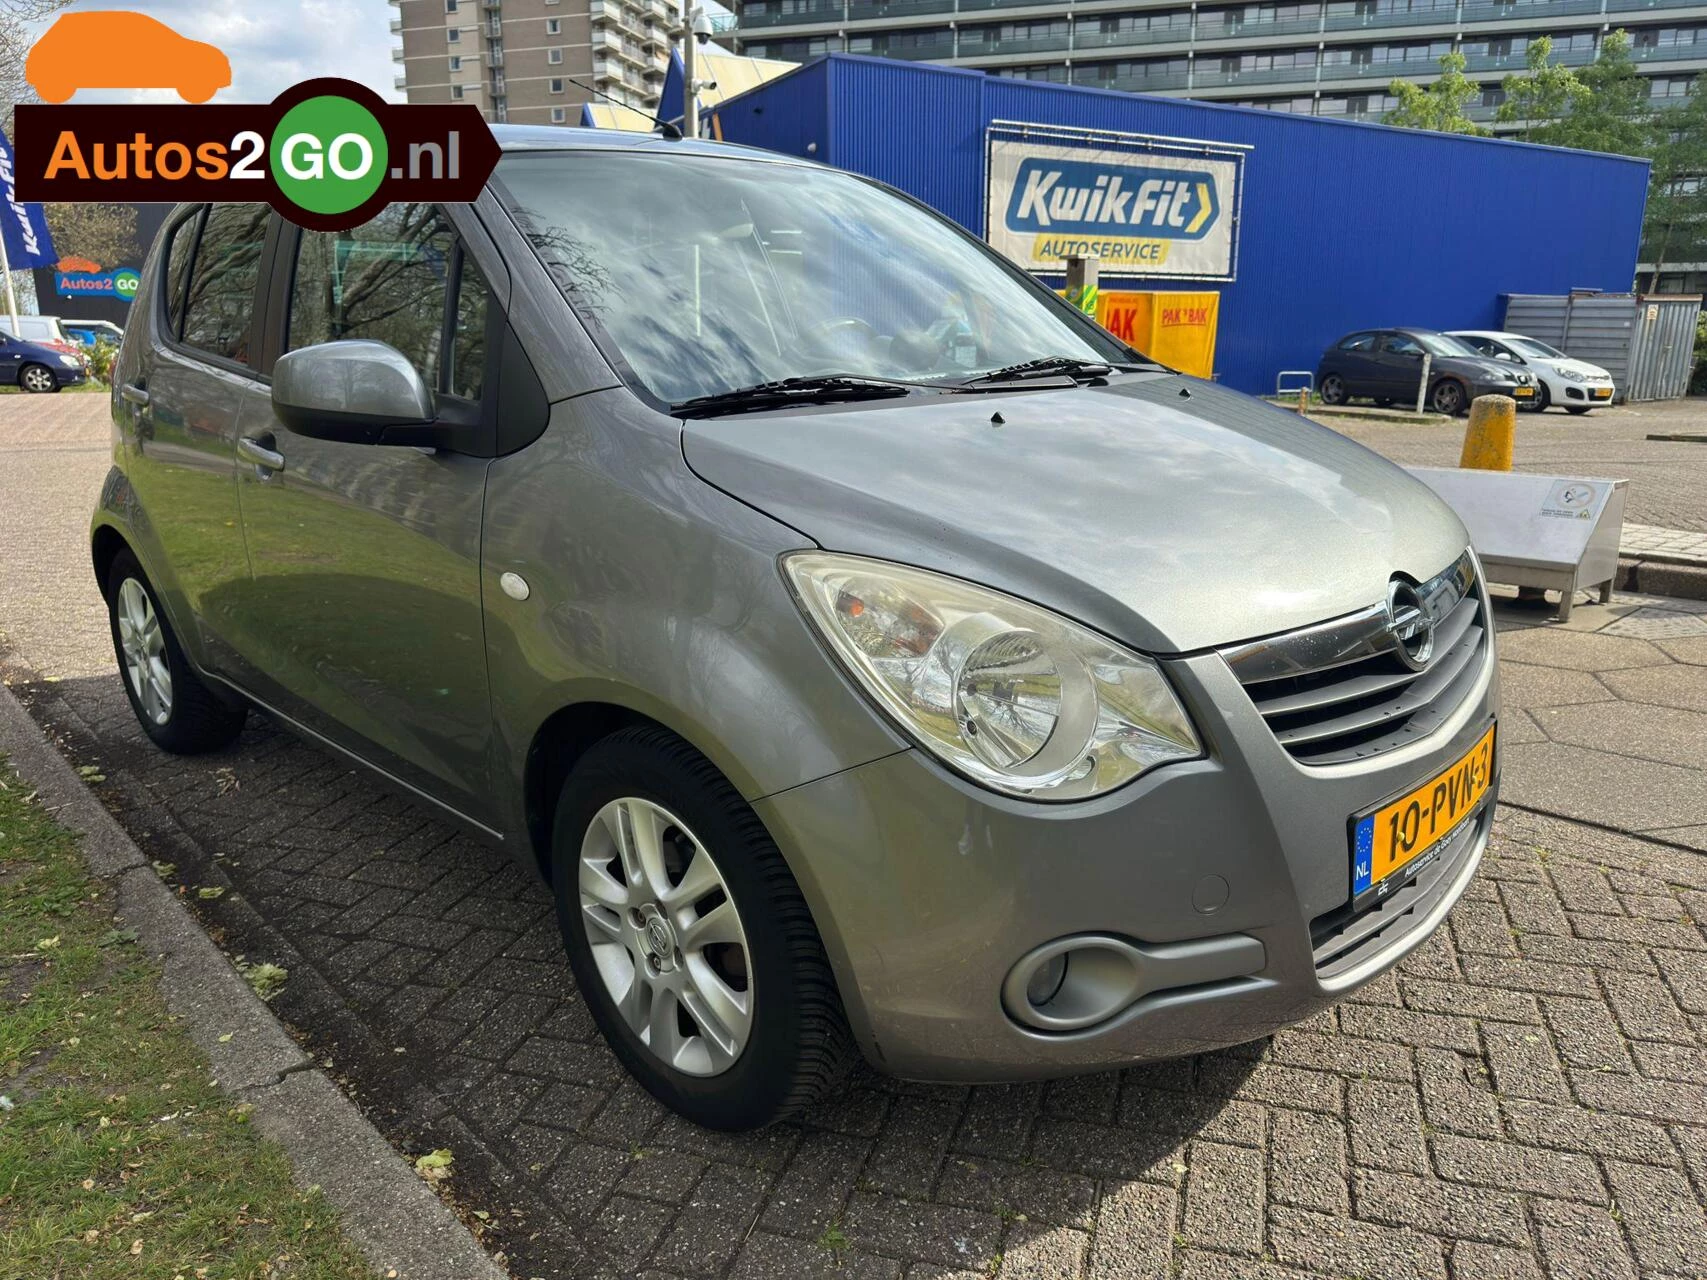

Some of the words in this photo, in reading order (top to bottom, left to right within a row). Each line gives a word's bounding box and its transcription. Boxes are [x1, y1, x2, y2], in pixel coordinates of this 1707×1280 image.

[1040, 240, 1161, 260] AUTOSERVICE
[1389, 742, 1489, 862] 10-PVN-3
[1355, 860, 1370, 881] NL
